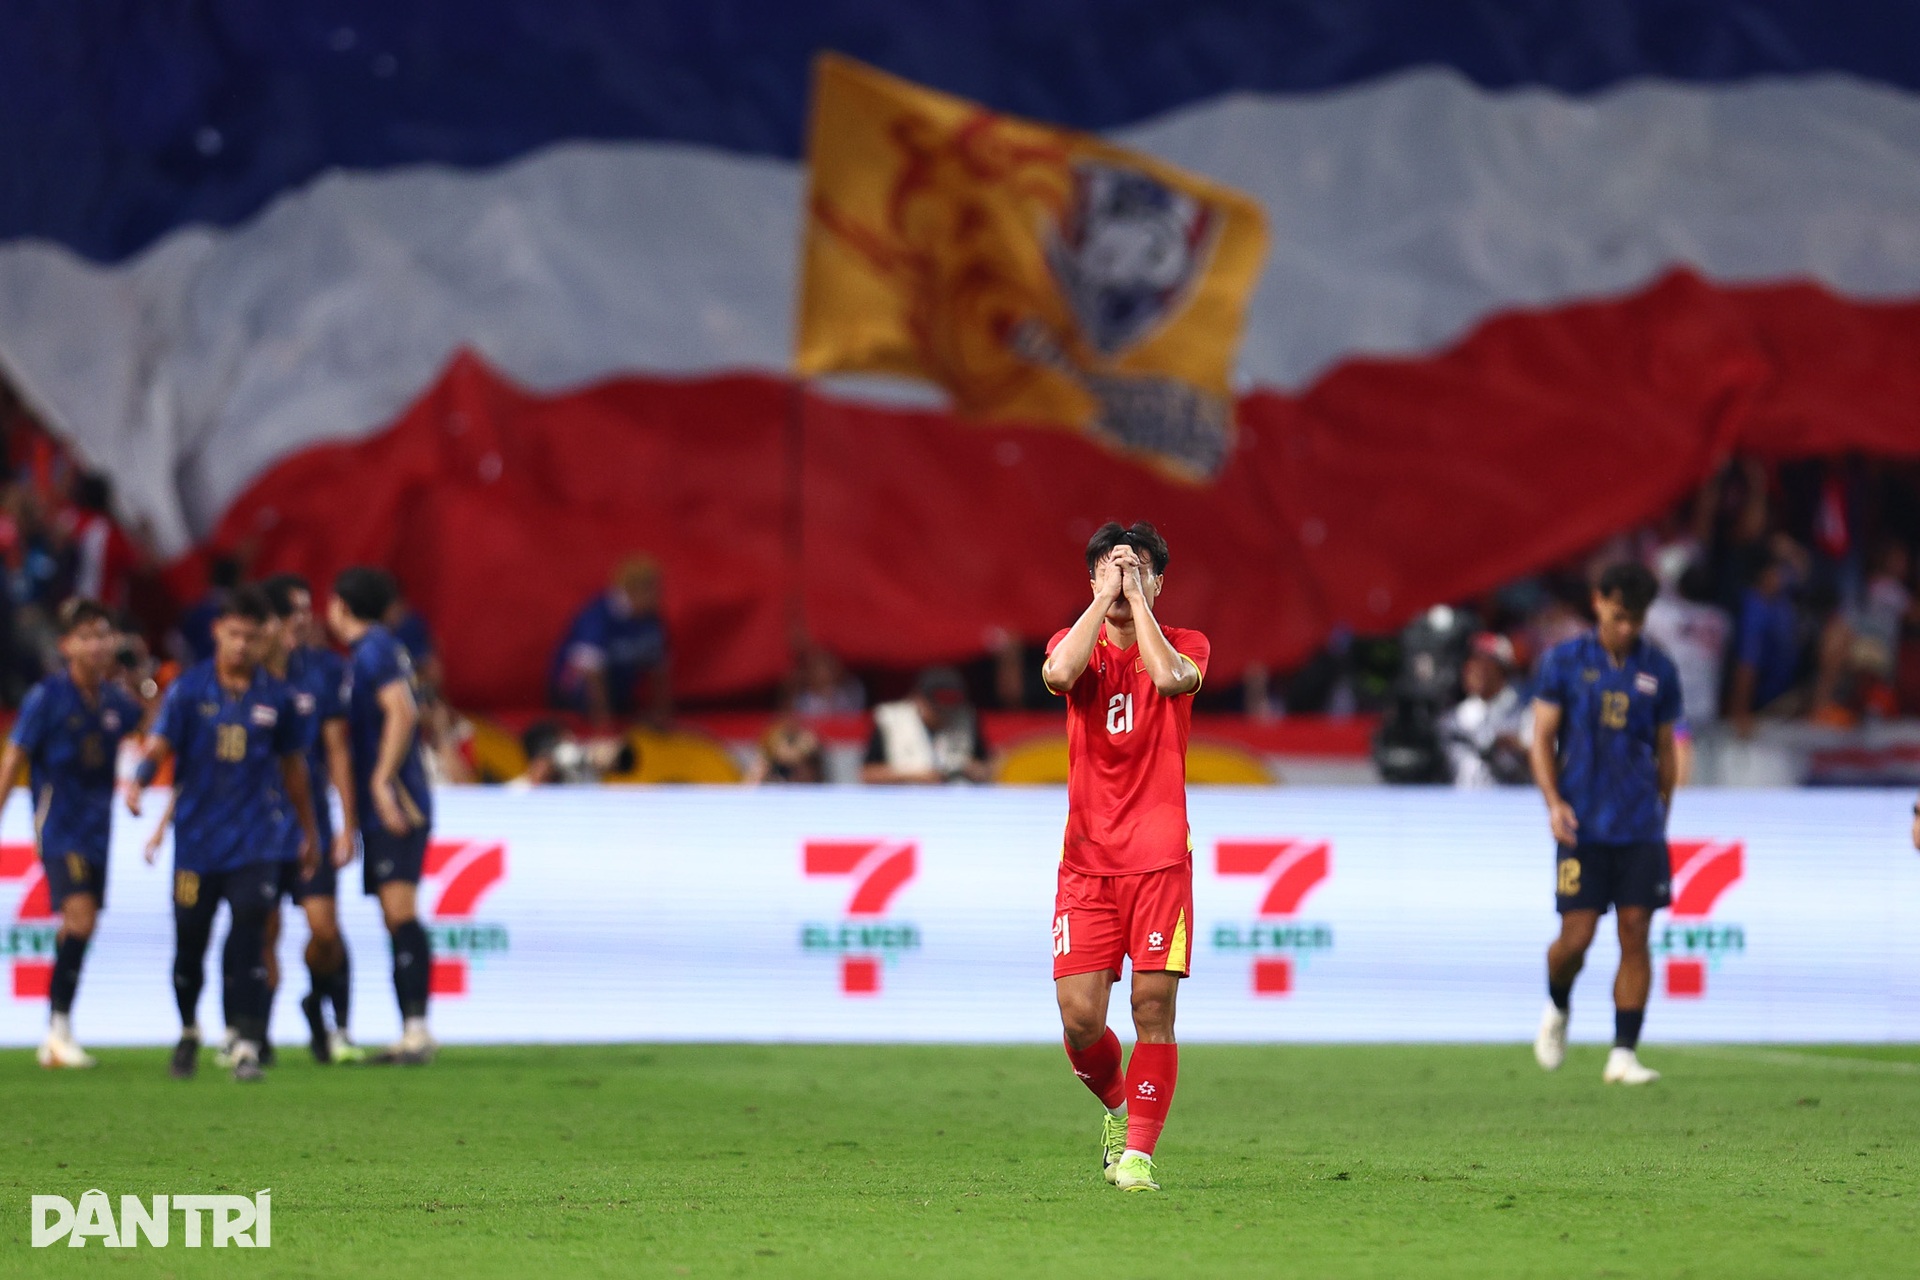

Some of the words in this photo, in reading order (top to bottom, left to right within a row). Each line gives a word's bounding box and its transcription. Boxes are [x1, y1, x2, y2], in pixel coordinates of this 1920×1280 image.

[1106, 693, 1134, 735] 21
[1602, 690, 1630, 729] 12
[1052, 913, 1071, 959] 21
